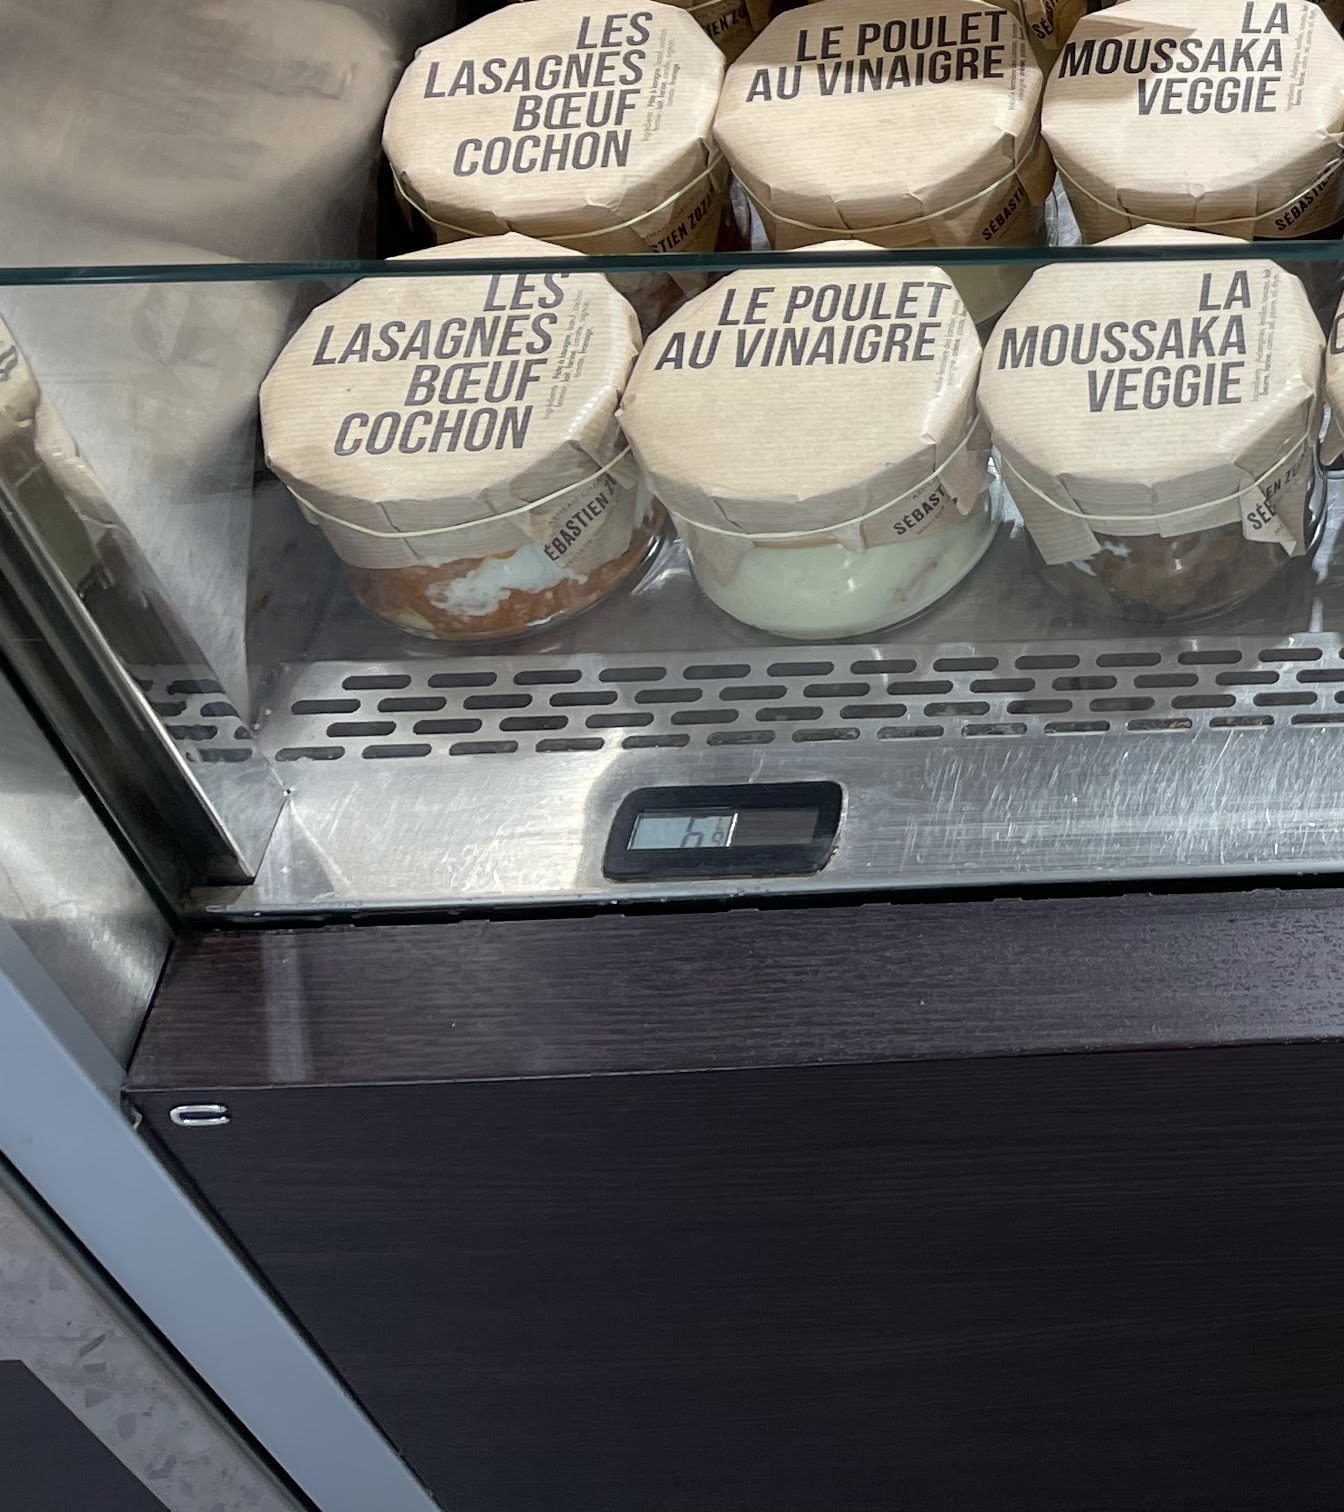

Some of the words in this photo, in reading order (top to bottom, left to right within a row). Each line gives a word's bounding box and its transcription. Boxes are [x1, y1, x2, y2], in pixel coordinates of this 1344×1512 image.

[483, 273, 569, 312] LES
[718, 287, 775, 326] LE
[783, 282, 952, 324] POULET
[1199, 270, 1251, 311] LA
[312, 313, 558, 366] LASAGNES
[654, 330, 721, 371] AU
[734, 322, 941, 368] VINAIGRE
[997, 315, 1246, 370] MOUSSAKA
[404, 358, 547, 407] BŒUF
[1088, 361, 1245, 412] VEGGIE
[334, 406, 533, 456] COCHON
